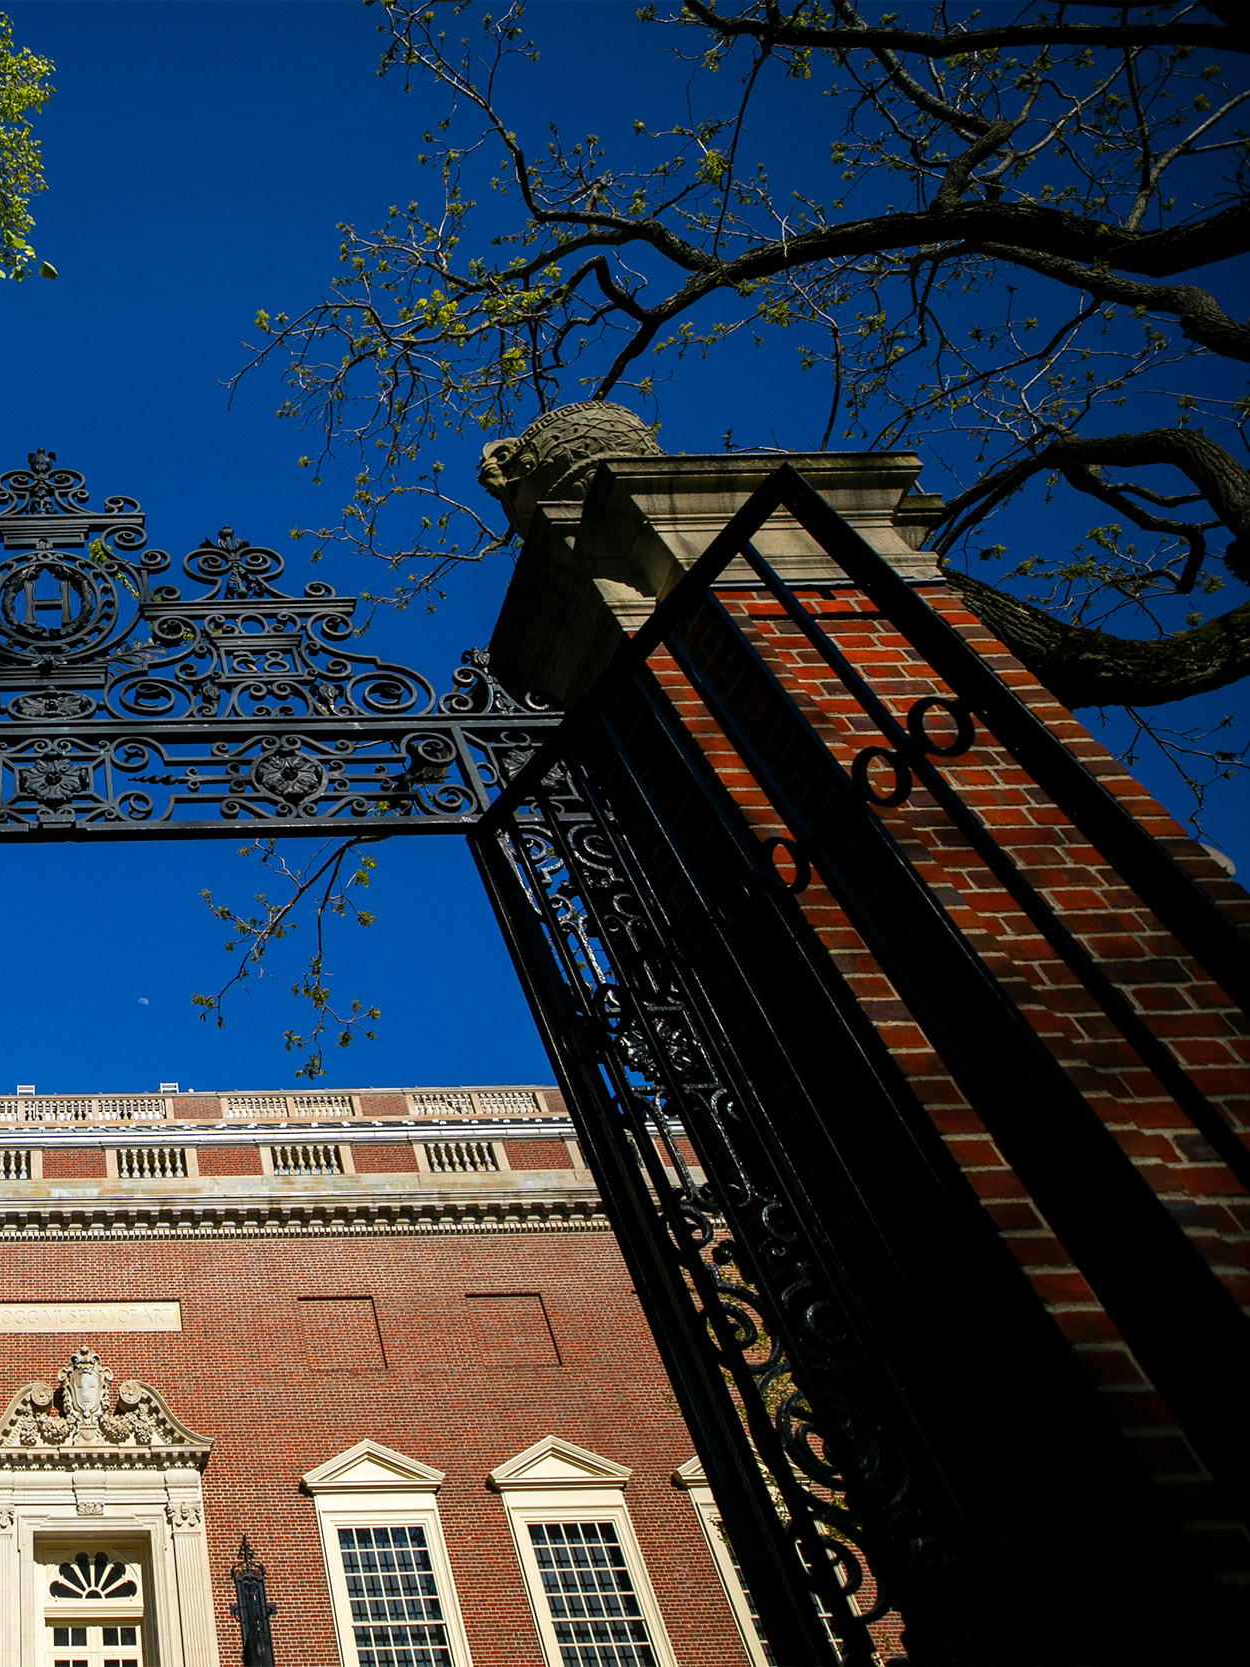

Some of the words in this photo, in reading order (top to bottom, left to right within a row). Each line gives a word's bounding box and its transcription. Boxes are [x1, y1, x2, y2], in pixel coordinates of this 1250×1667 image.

[24, 580, 72, 625] H
[42, 1309, 114, 1324] MUSEUM
[117, 1308, 138, 1324] OF
[142, 1307, 174, 1323] ART
